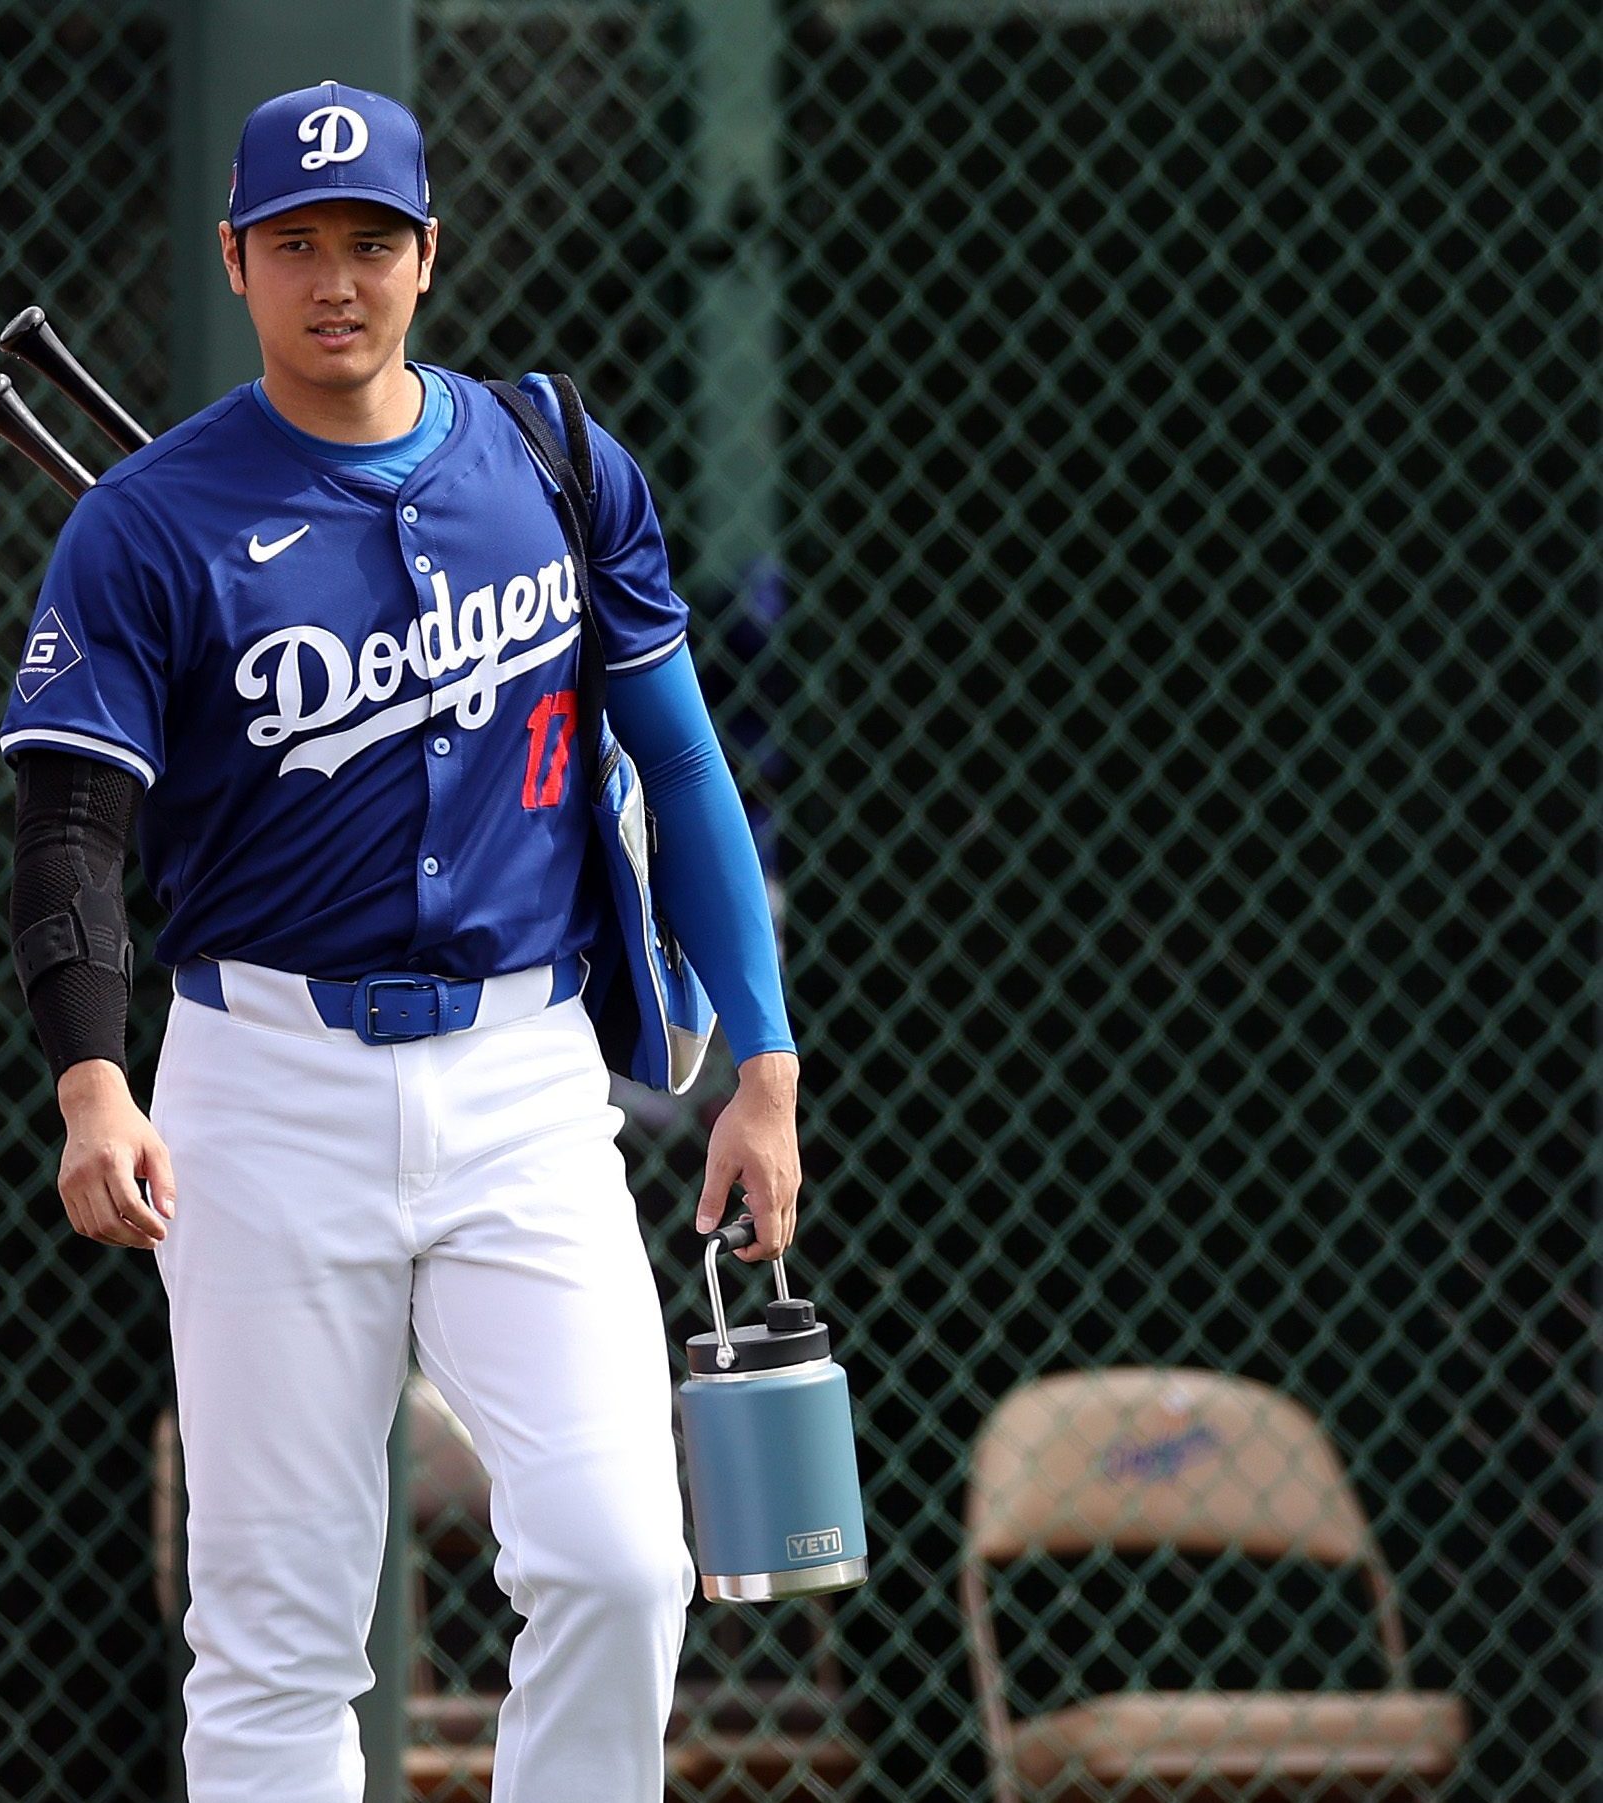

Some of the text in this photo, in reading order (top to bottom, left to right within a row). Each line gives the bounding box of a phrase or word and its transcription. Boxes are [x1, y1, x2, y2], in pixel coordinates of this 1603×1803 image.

[298, 105, 369, 170] D
[25, 632, 59, 664] G
[521, 690, 577, 812] 17
[790, 1533, 838, 1556] YETI
